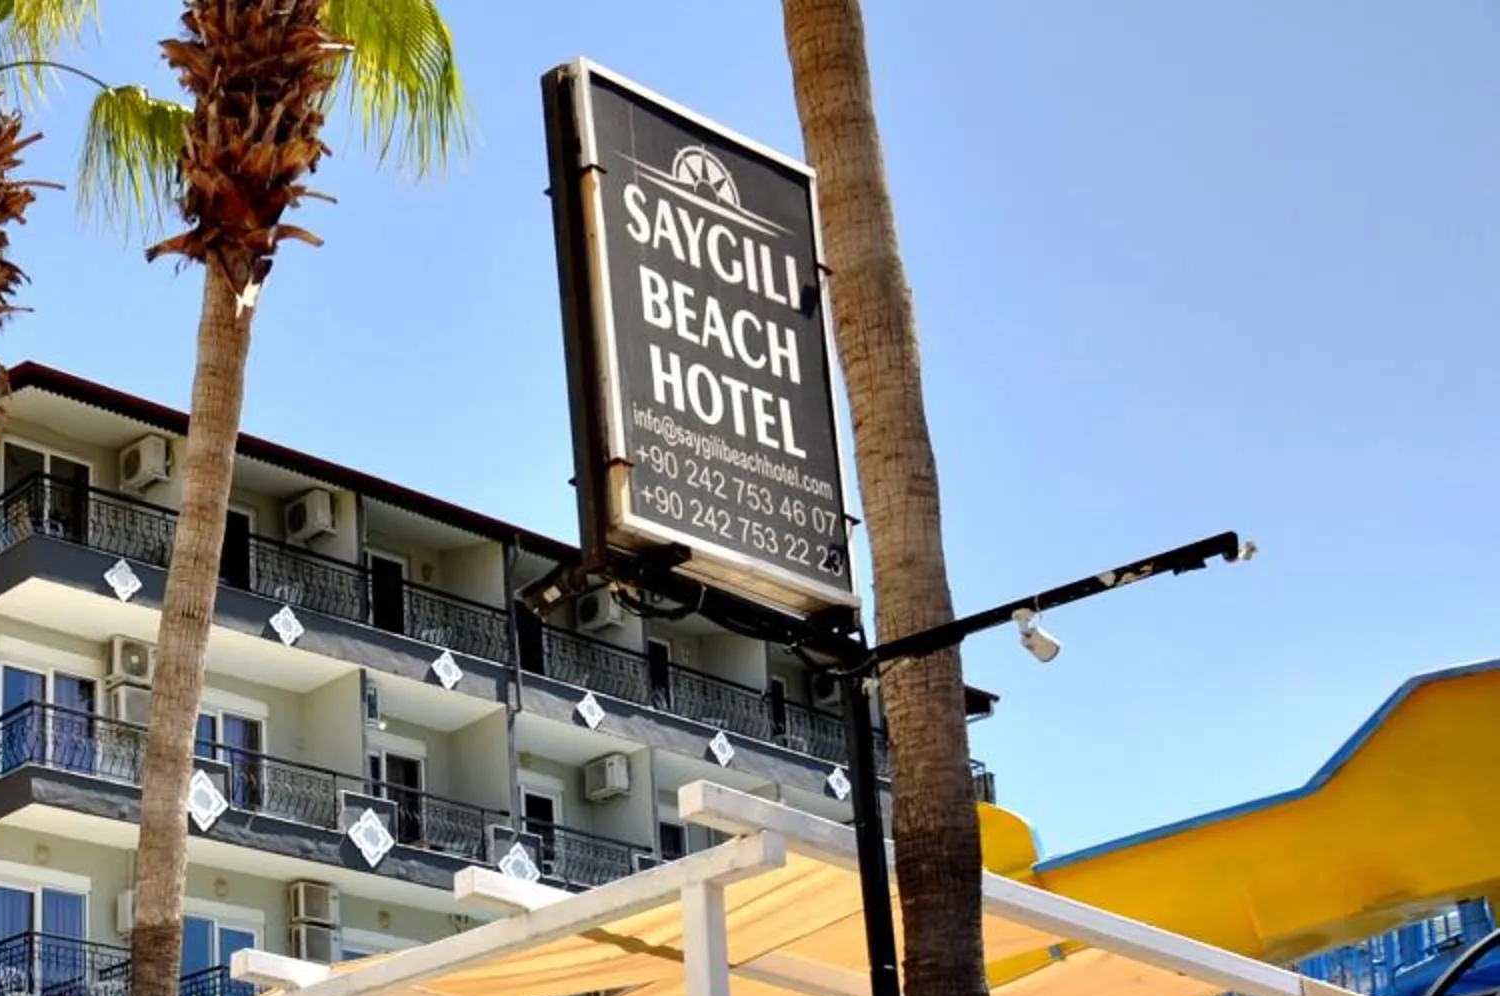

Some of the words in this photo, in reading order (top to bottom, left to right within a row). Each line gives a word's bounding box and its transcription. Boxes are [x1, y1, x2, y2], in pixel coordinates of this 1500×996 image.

[623, 183, 800, 311] SAYGILI
[639, 264, 801, 385] BEACH
[633, 402, 834, 500] info@saygilibeachhotel.com
[650, 343, 807, 460] HOTEL
[636, 444, 679, 480] +90
[684, 458, 728, 500] 242
[733, 477, 774, 516] 753
[779, 496, 807, 527] 46
[812, 506, 837, 537] 07
[641, 484, 683, 520] +90
[689, 499, 733, 540] 242
[737, 517, 779, 554] 753
[784, 533, 811, 566] 22
